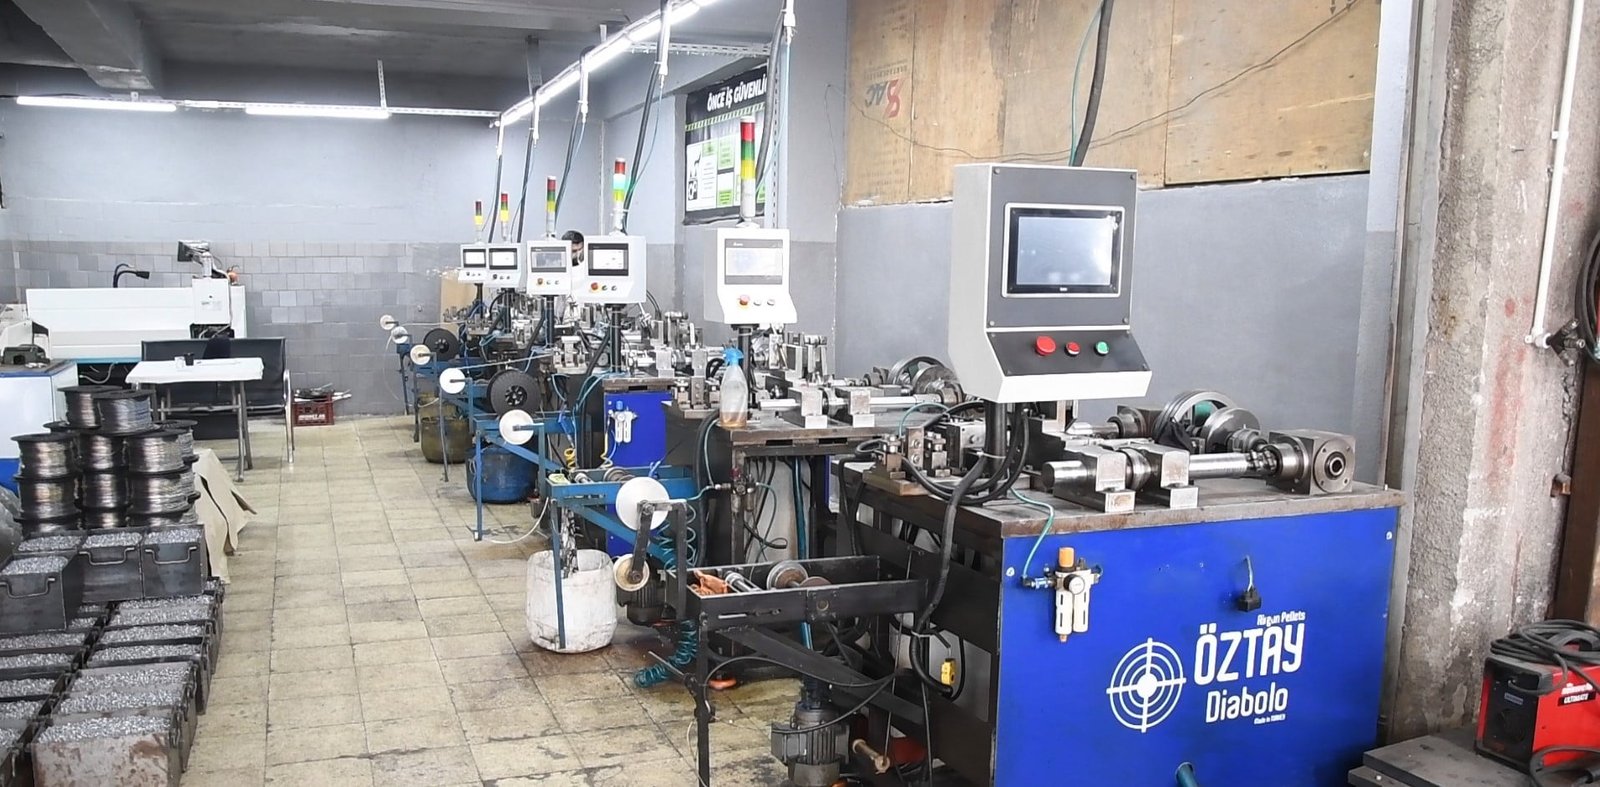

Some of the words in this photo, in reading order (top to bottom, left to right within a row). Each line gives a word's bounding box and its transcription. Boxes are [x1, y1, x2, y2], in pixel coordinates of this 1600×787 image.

[707, 91, 726, 112] ÖNCE
[725, 86, 733, 109] İŞ
[1281, 610, 1306, 623] Pellets
[1193, 622, 1305, 686] ÖZTAY
[1205, 681, 1289, 723] Diabolo
